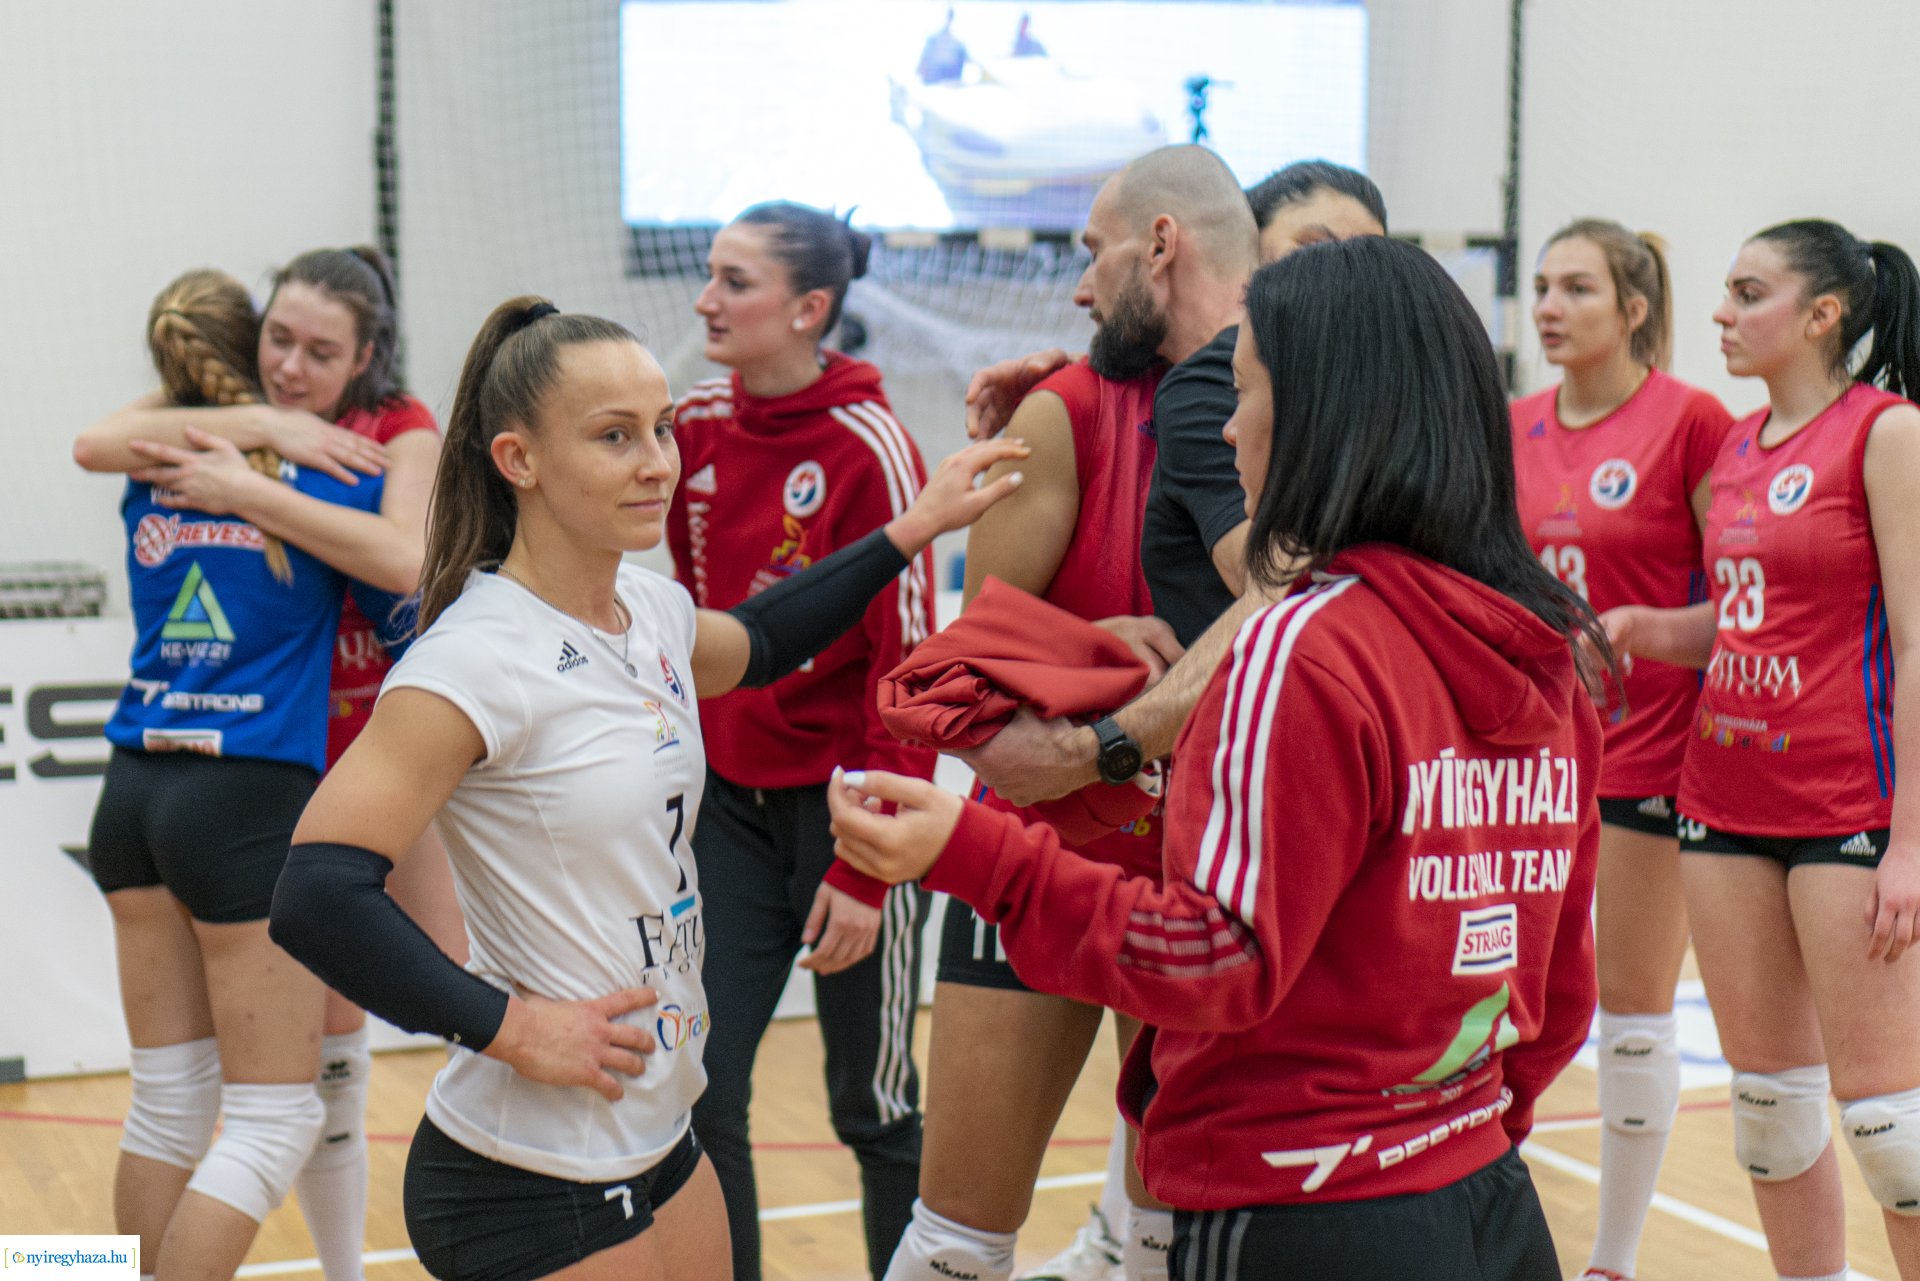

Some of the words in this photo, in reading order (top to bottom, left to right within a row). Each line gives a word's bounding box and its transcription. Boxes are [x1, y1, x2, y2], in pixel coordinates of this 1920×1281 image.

[1714, 557, 1765, 631] 23
[557, 655, 588, 673] adidas
[666, 793, 687, 893] 7
[604, 1186, 633, 1219] 7
